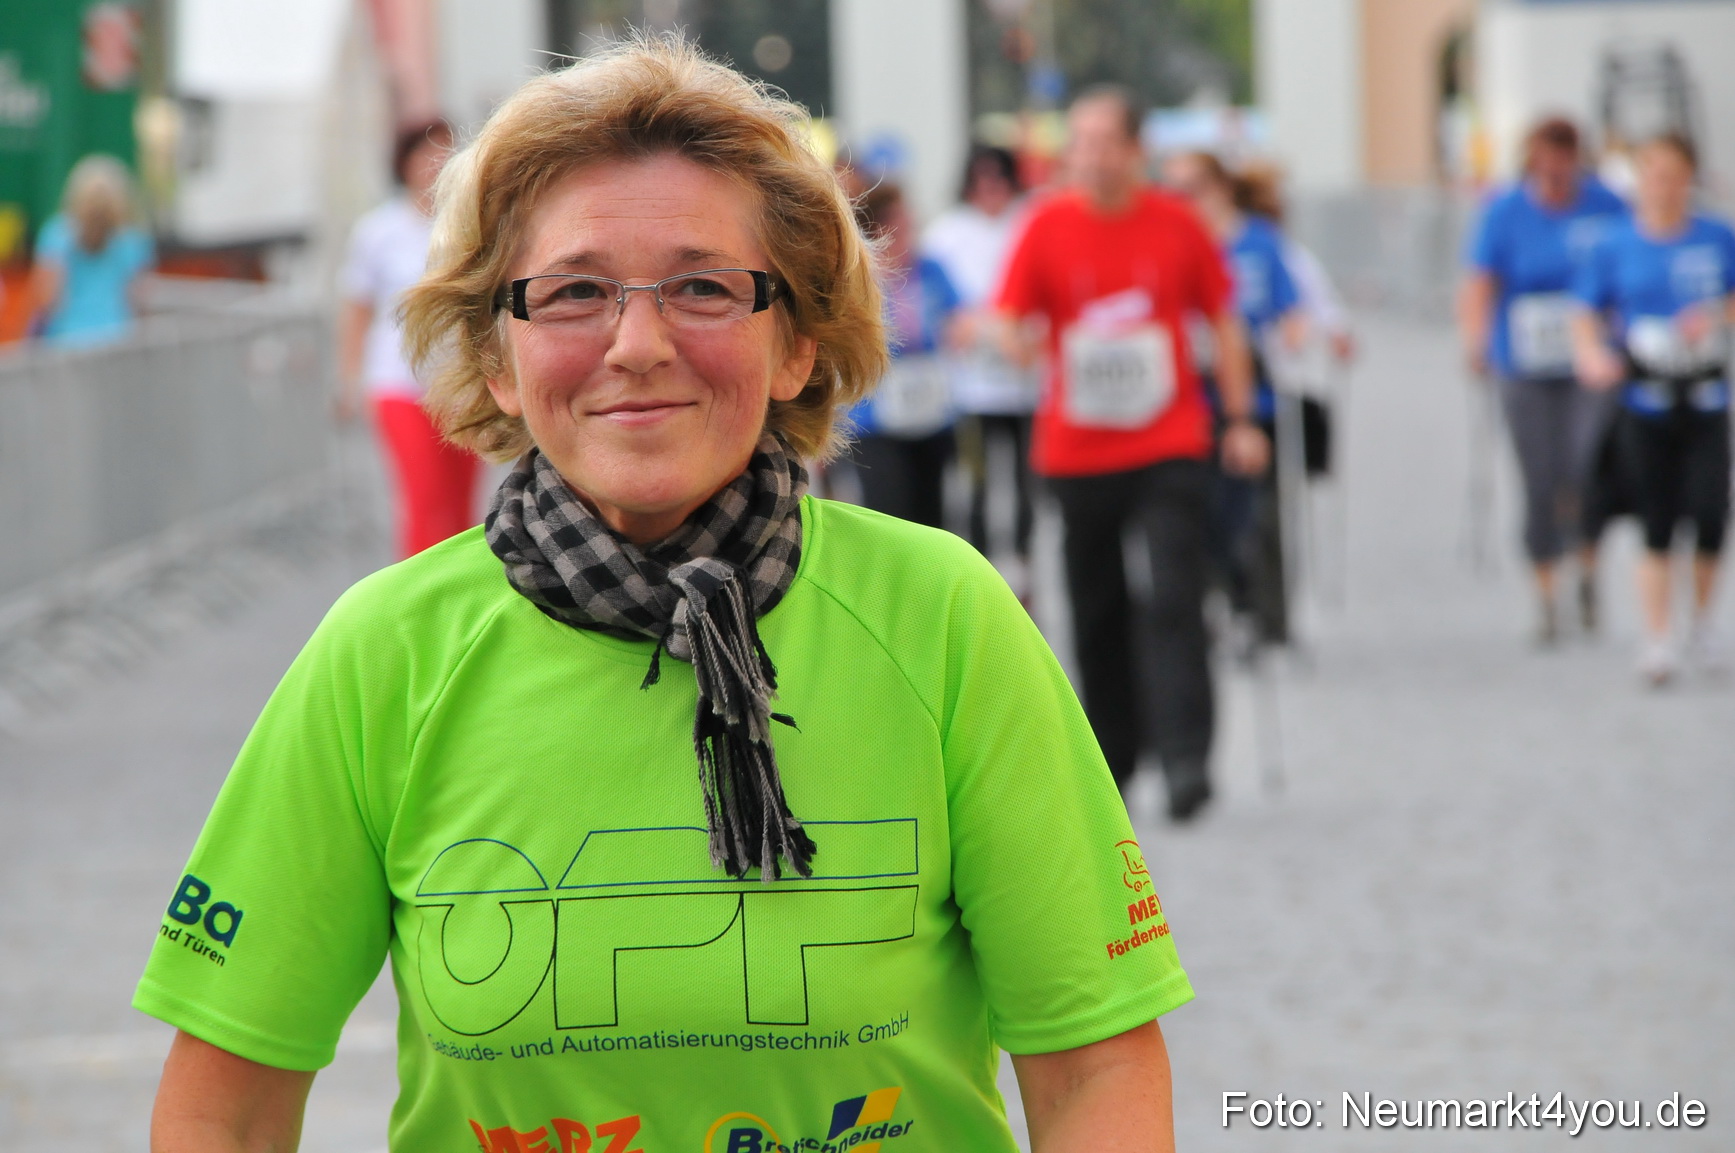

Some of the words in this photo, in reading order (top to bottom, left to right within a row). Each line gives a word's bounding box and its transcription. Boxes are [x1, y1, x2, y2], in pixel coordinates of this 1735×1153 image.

[1127, 893, 1163, 926] ME
[183, 932, 225, 967] Türen
[511, 1037, 554, 1059] und
[562, 1029, 850, 1053] Automatisierungstechnik
[857, 1010, 910, 1044] GmbH
